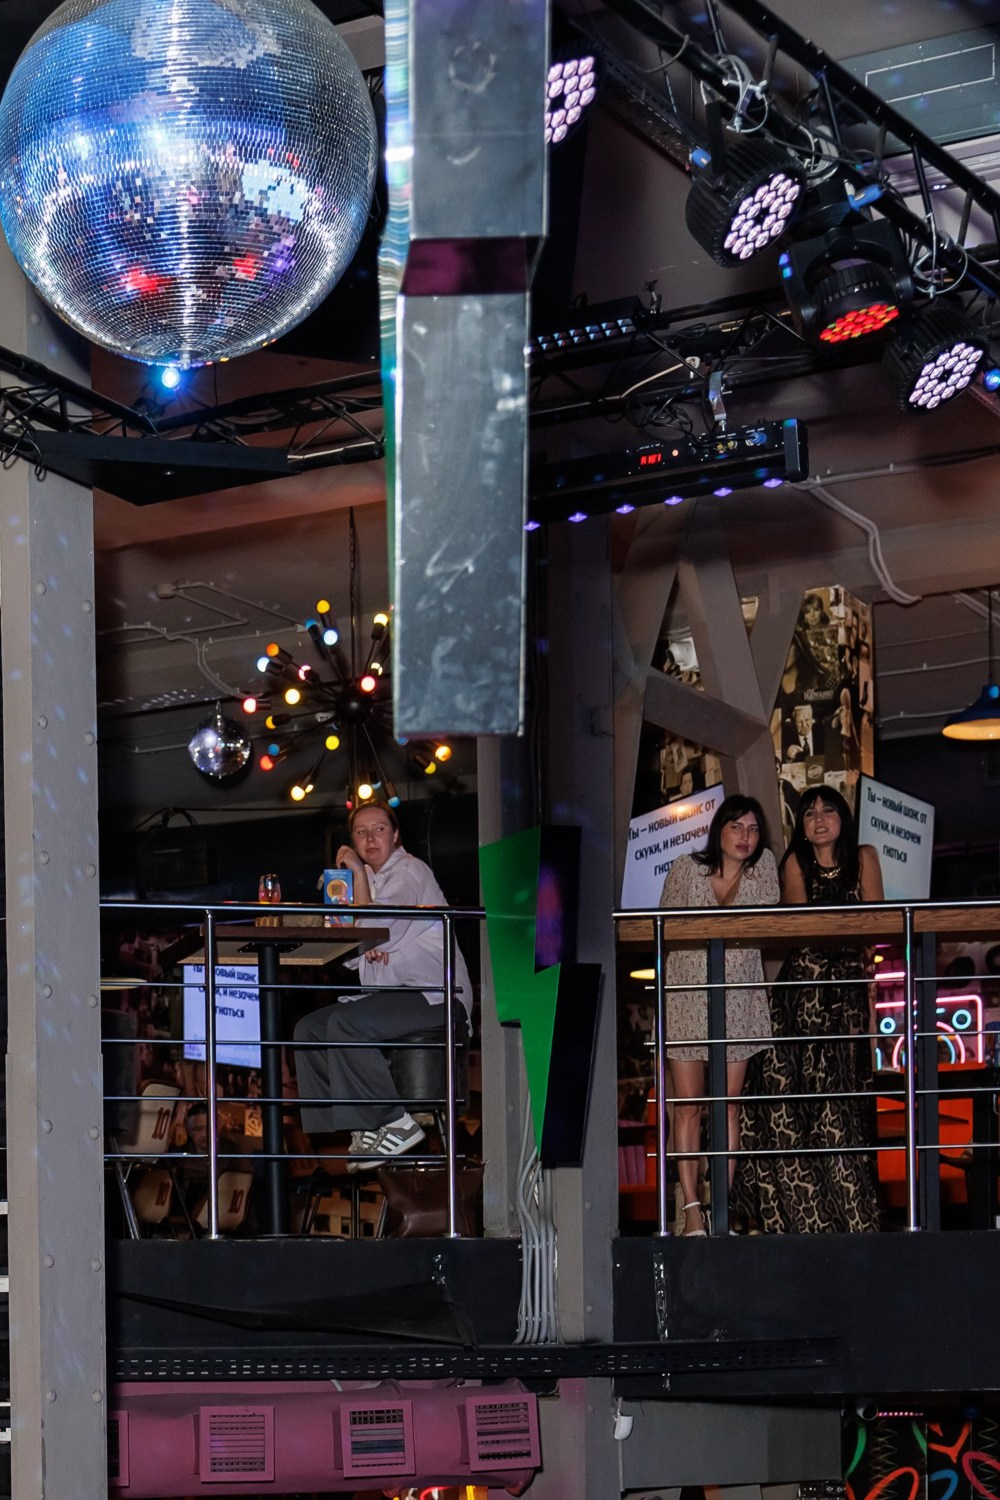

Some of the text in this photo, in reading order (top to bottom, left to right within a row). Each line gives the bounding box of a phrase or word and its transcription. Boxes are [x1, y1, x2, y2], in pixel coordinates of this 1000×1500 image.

[866, 787, 876, 803] Ты
[882, 796, 903, 814] новый
[903, 804, 920, 821] шанс
[920, 812, 928, 824] от
[628, 827, 639, 841] Ты
[648, 814, 678, 834] новый
[679, 803, 704, 821] шанс
[704, 799, 716, 812] от
[634, 825, 709, 861] скуки, и незачем
[896, 824, 922, 845] незачем
[883, 844, 908, 863] гнаться
[215, 968, 236, 979] овый
[151, 1107, 171, 1140] 10
[155, 1181, 170, 1206] 10
[228, 1189, 244, 1214] 10
